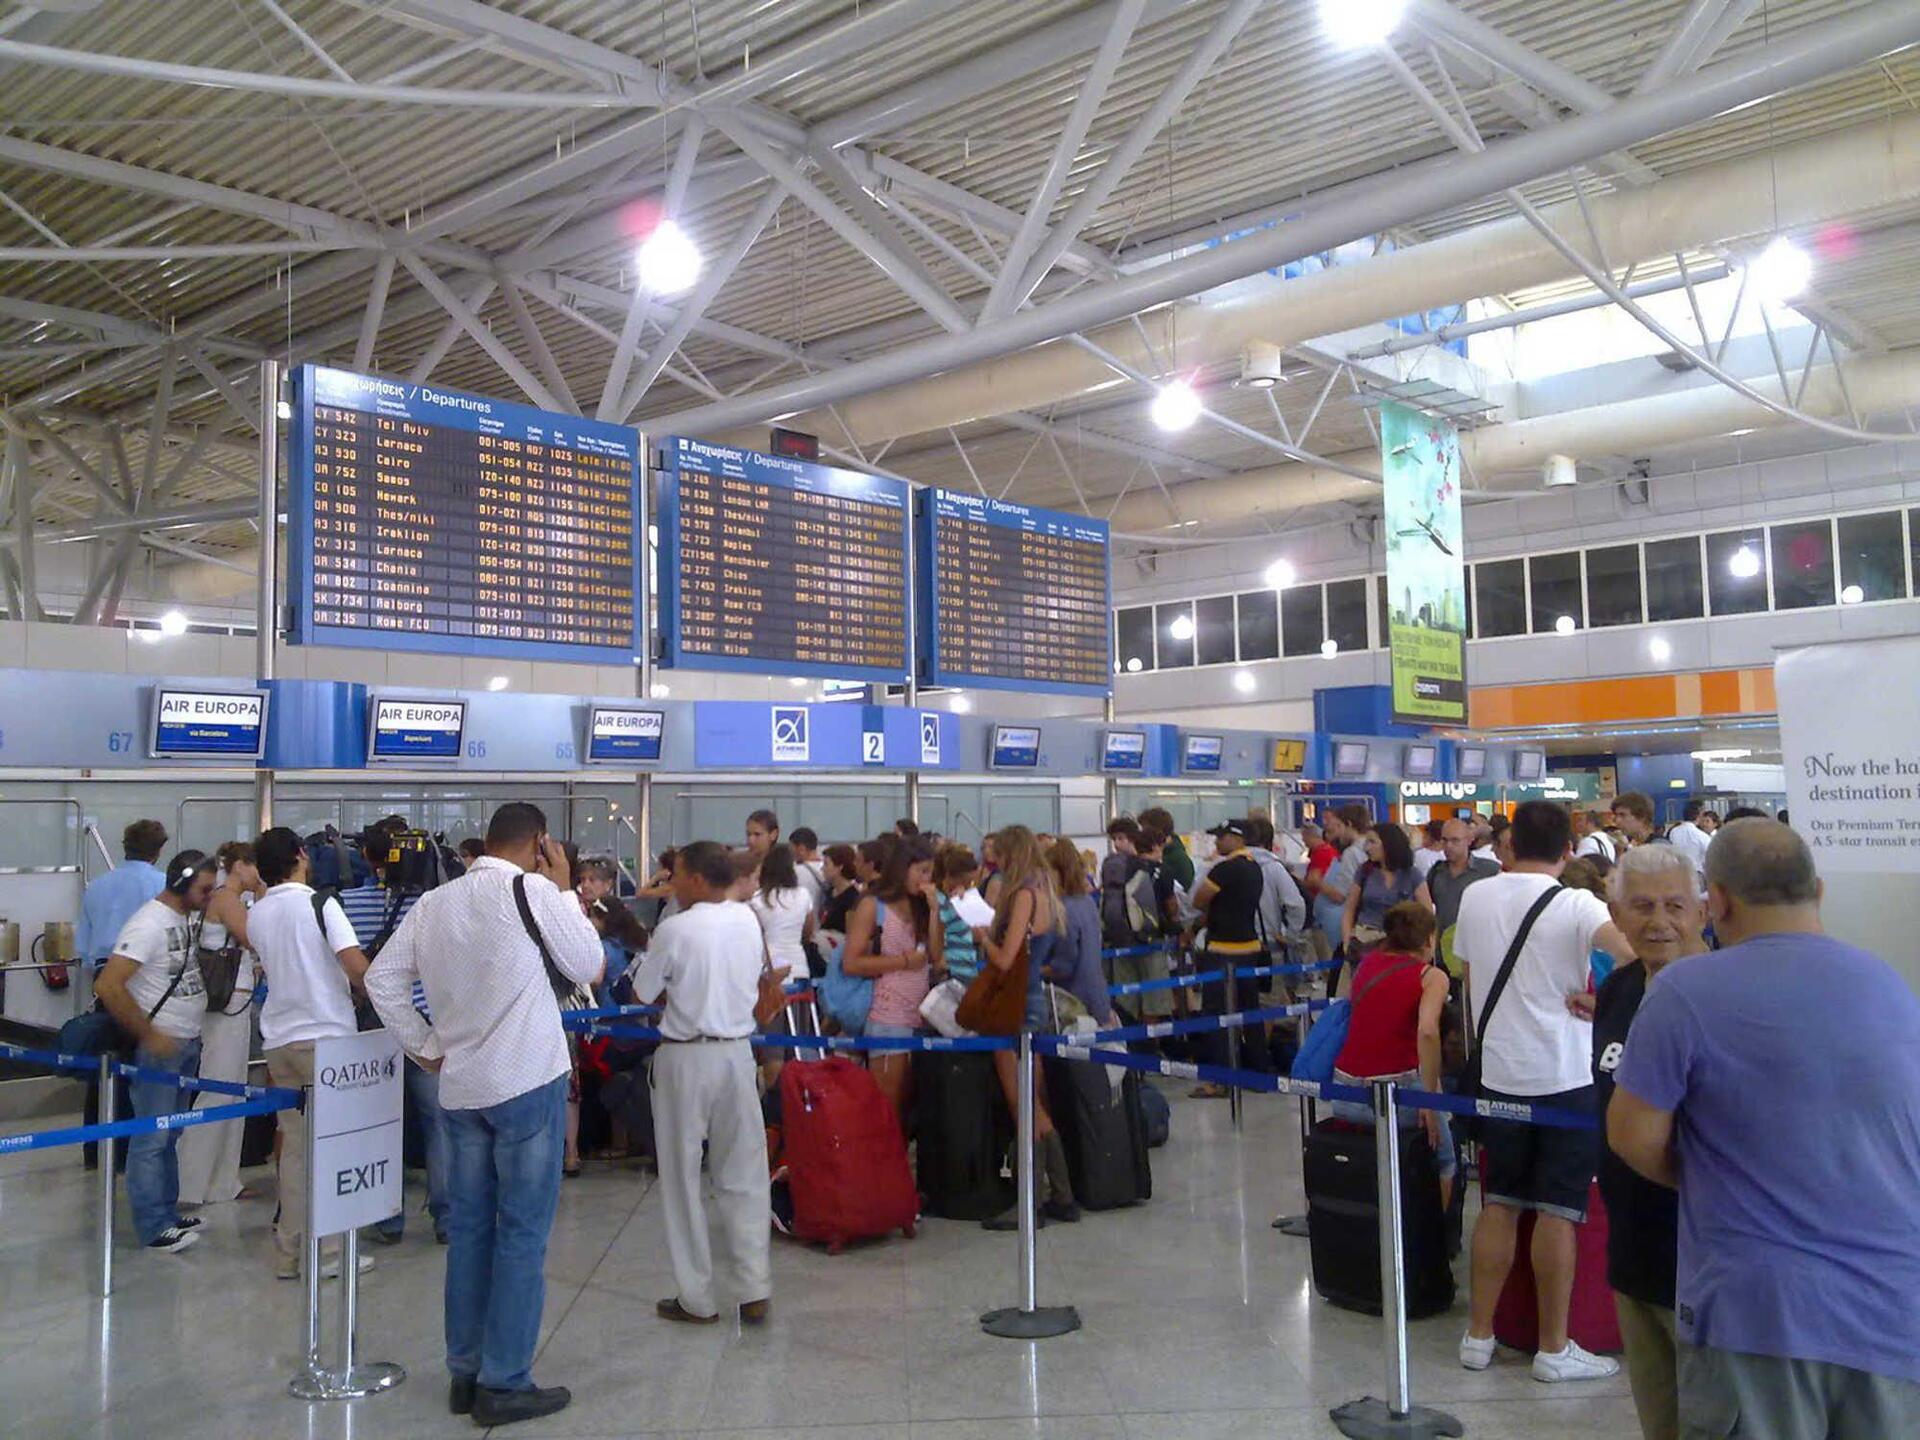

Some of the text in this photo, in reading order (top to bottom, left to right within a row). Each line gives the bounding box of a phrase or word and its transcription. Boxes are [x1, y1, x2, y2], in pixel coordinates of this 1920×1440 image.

[422, 388, 491, 414] Departures
[336, 411, 356, 425] 542
[376, 418, 394, 432] Tel
[403, 423, 429, 437] Aviv
[479, 436, 520, 453] 001-005
[550, 449, 572, 462] 1025
[315, 425, 328, 439] CY
[335, 429, 356, 443] 323
[376, 436, 422, 454] Larnaca
[479, 453, 521, 470] 051-054
[550, 465, 572, 478] 1035
[376, 454, 410, 470] Cairo
[479, 470, 521, 487] 120-140
[550, 481, 572, 494] 1140
[335, 466, 356, 479] 752
[550, 498, 572, 511] 1155
[335, 484, 356, 498] 105
[479, 504, 521, 520] 017-021
[551, 514, 572, 527] 1200
[376, 526, 429, 542] Iraklion
[479, 538, 521, 553] 120-142
[551, 547, 573, 559] 1245
[551, 531, 573, 543] 1240
[314, 536, 327, 549] CY
[335, 539, 356, 552] 313
[376, 544, 422, 559] Larnaca
[551, 564, 573, 576] 1250
[335, 557, 356, 570] 534
[376, 561, 416, 576] Chania
[376, 579, 429, 595] Ioannina
[551, 597, 573, 608] 1300
[314, 592, 327, 604] SK
[335, 594, 362, 607] 7734
[479, 607, 521, 620] 012-013
[551, 613, 573, 624] 1315
[335, 612, 356, 625] 235
[410, 618, 429, 630] FCO
[552, 629, 573, 641] 1330
[162, 700, 258, 715] AIR EUROPA
[379, 708, 460, 721] AIR EUROPA
[594, 716, 660, 728] AIR EUROPA
[108, 732, 133, 753] 67
[467, 741, 486, 758] 66
[869, 735, 880, 759] 2
[1804, 752, 1856, 778] Now
[1862, 759, 1890, 776] the
[1809, 784, 1911, 801] destination
[1811, 819, 1833, 831] Our
[1838, 818, 1893, 831] Premium
[1813, 836, 1822, 847] A
[1866, 836, 1906, 847] transit
[320, 1059, 380, 1088] QATAR
[0, 1133, 33, 1147] THENS
[336, 1159, 389, 1197] EXIT
